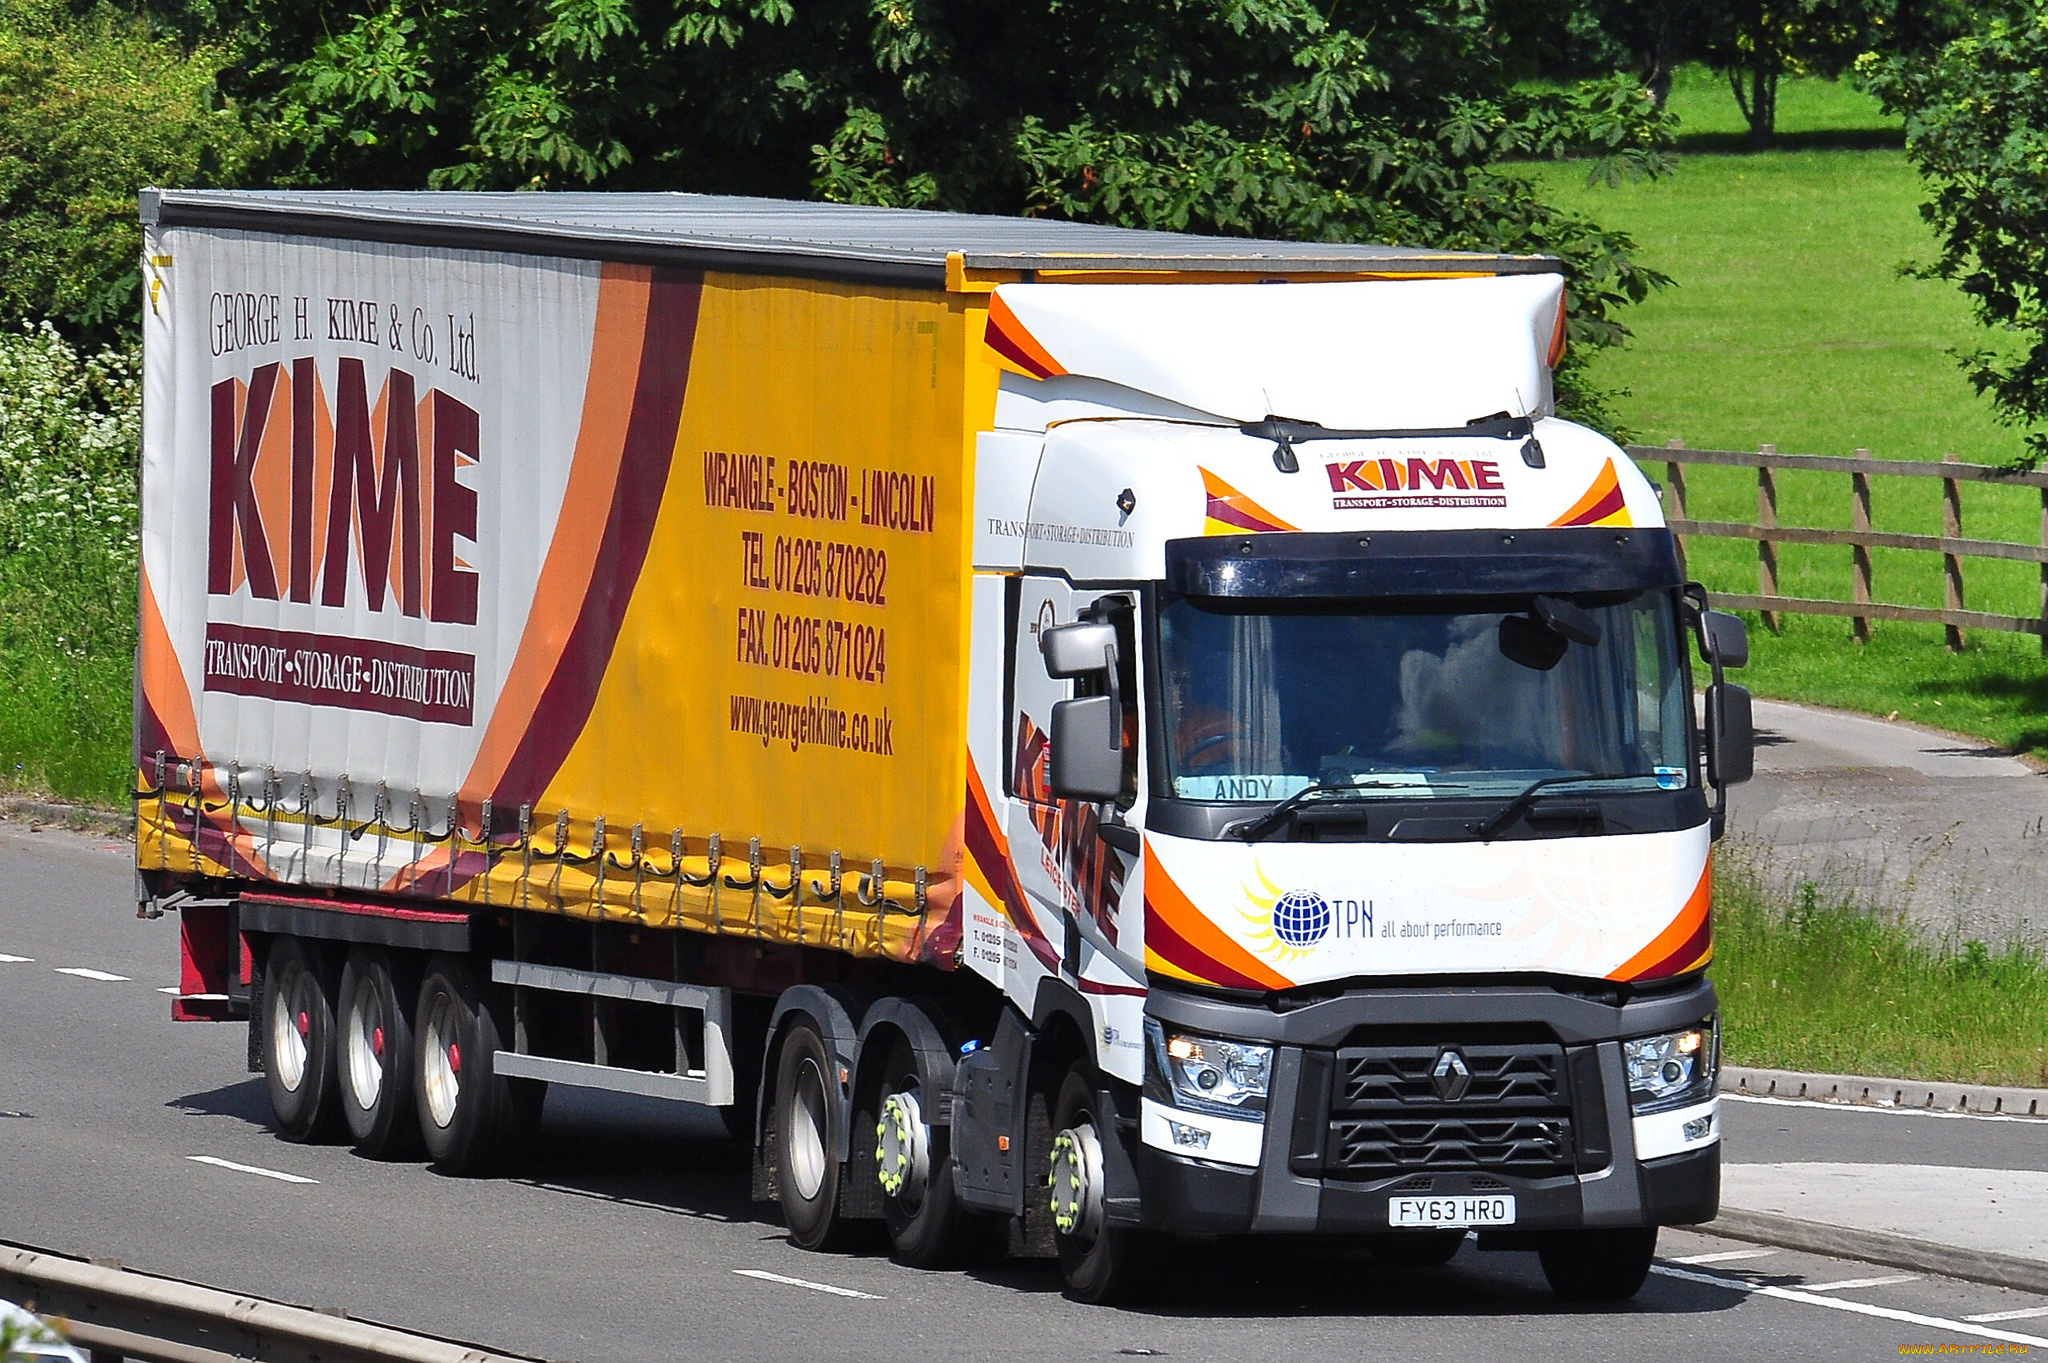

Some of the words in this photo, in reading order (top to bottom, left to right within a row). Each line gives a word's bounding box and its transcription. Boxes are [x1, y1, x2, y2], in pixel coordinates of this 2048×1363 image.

[210, 293, 280, 357] GEORGE
[294, 296, 313, 341] H.
[327, 298, 379, 346] KIME
[389, 303, 403, 352] &
[412, 307, 438, 366] Co.
[448, 312, 480, 384] Ltd.
[207, 356, 480, 626] KIME
[704, 451, 775, 512] WRANGLE
[788, 459, 848, 521] BOSTON
[861, 468, 934, 532] LINCOLN
[1325, 457, 1506, 493] KIME
[742, 531, 769, 589] TEL.
[774, 535, 822, 597] 01205
[825, 542, 887, 605] 870282
[737, 608, 768, 666] FAX.
[773, 613, 821, 675] 01205
[825, 619, 886, 684] 871024
[730, 695, 894, 756] www.georgehkime.co.uk
[1215, 779, 1274, 800] ANDY
[1332, 900, 1374, 938] TPN
[1381, 920, 1396, 938] all
[1400, 920, 1430, 938] about
[1434, 918, 1502, 940] performance
[1400, 1200, 1456, 1221] FY63
